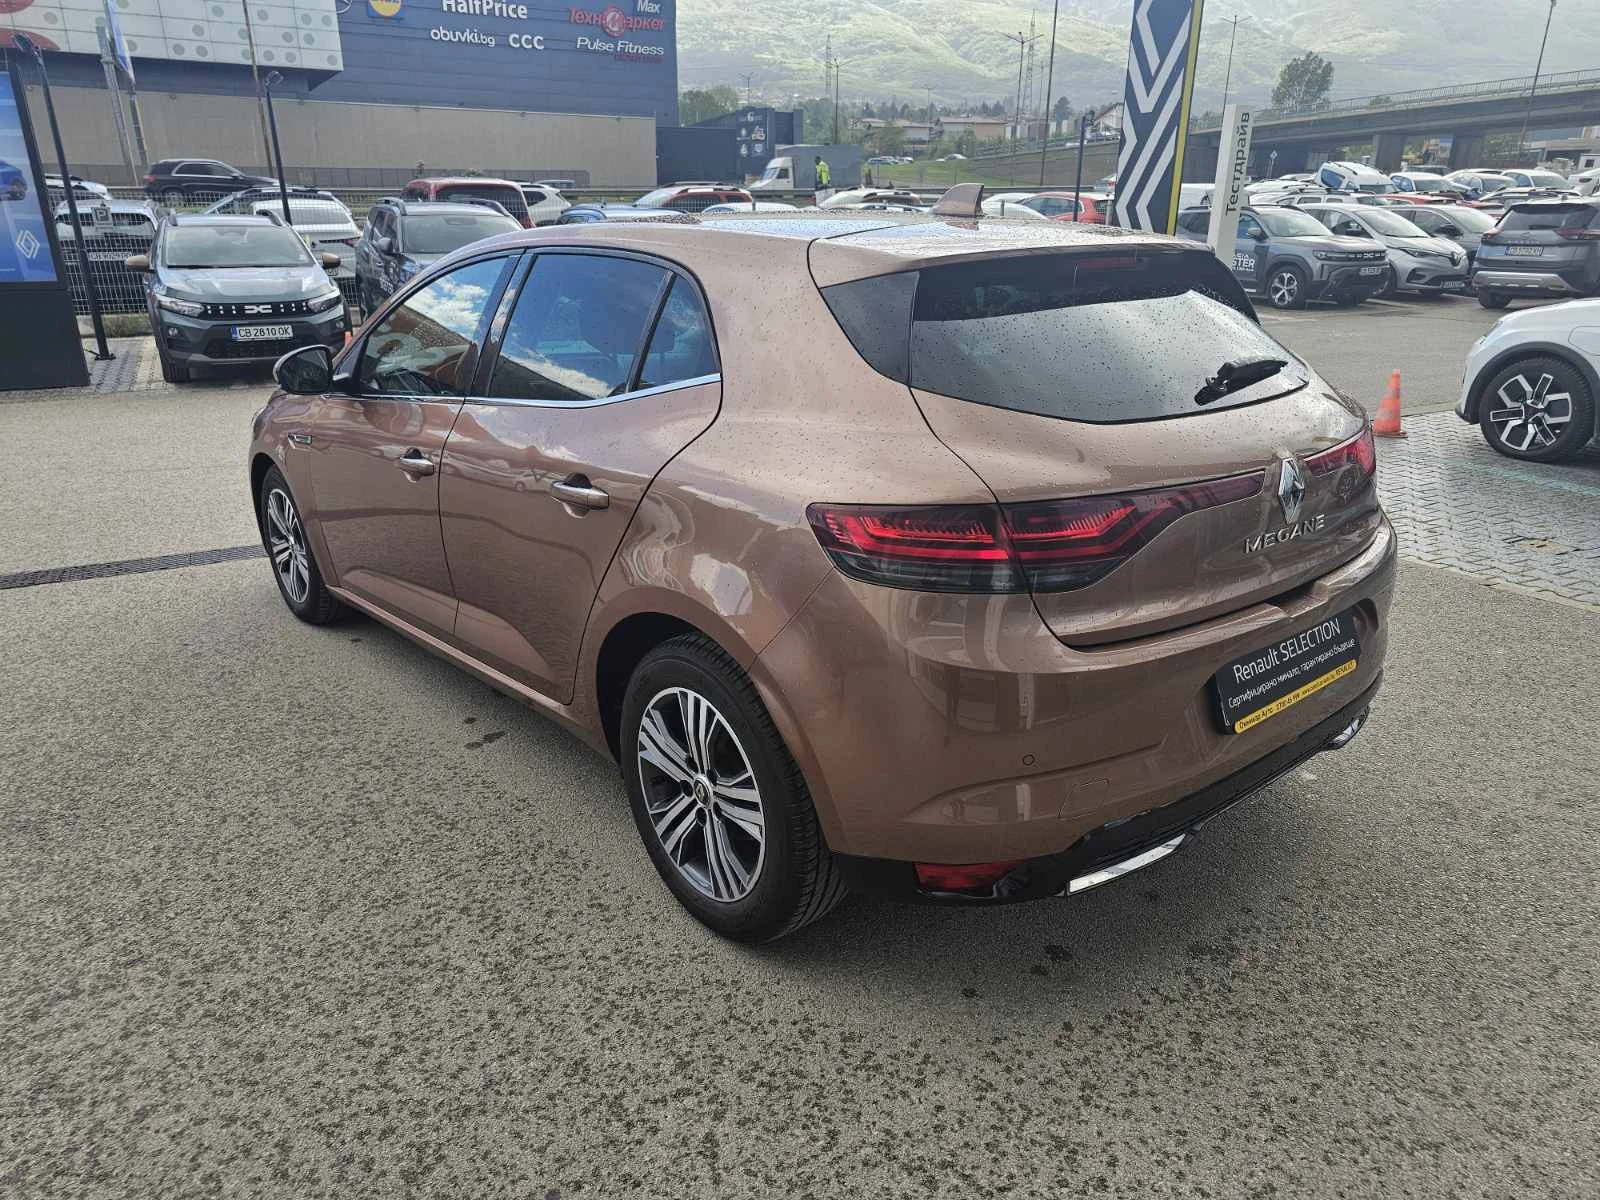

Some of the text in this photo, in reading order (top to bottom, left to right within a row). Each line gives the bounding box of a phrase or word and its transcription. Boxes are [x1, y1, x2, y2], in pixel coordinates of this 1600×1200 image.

[442, 0, 528, 19] HalfPrice
[430, 26, 545, 50] obuvki.bg CCC
[576, 36, 665, 56] Pulse Fitness
[1226, 112, 1250, 216] Тестдрайв
[1244, 514, 1325, 554] MEGANE
[1233, 648, 1280, 684] Renault
[1279, 618, 1341, 662] SELECTION
